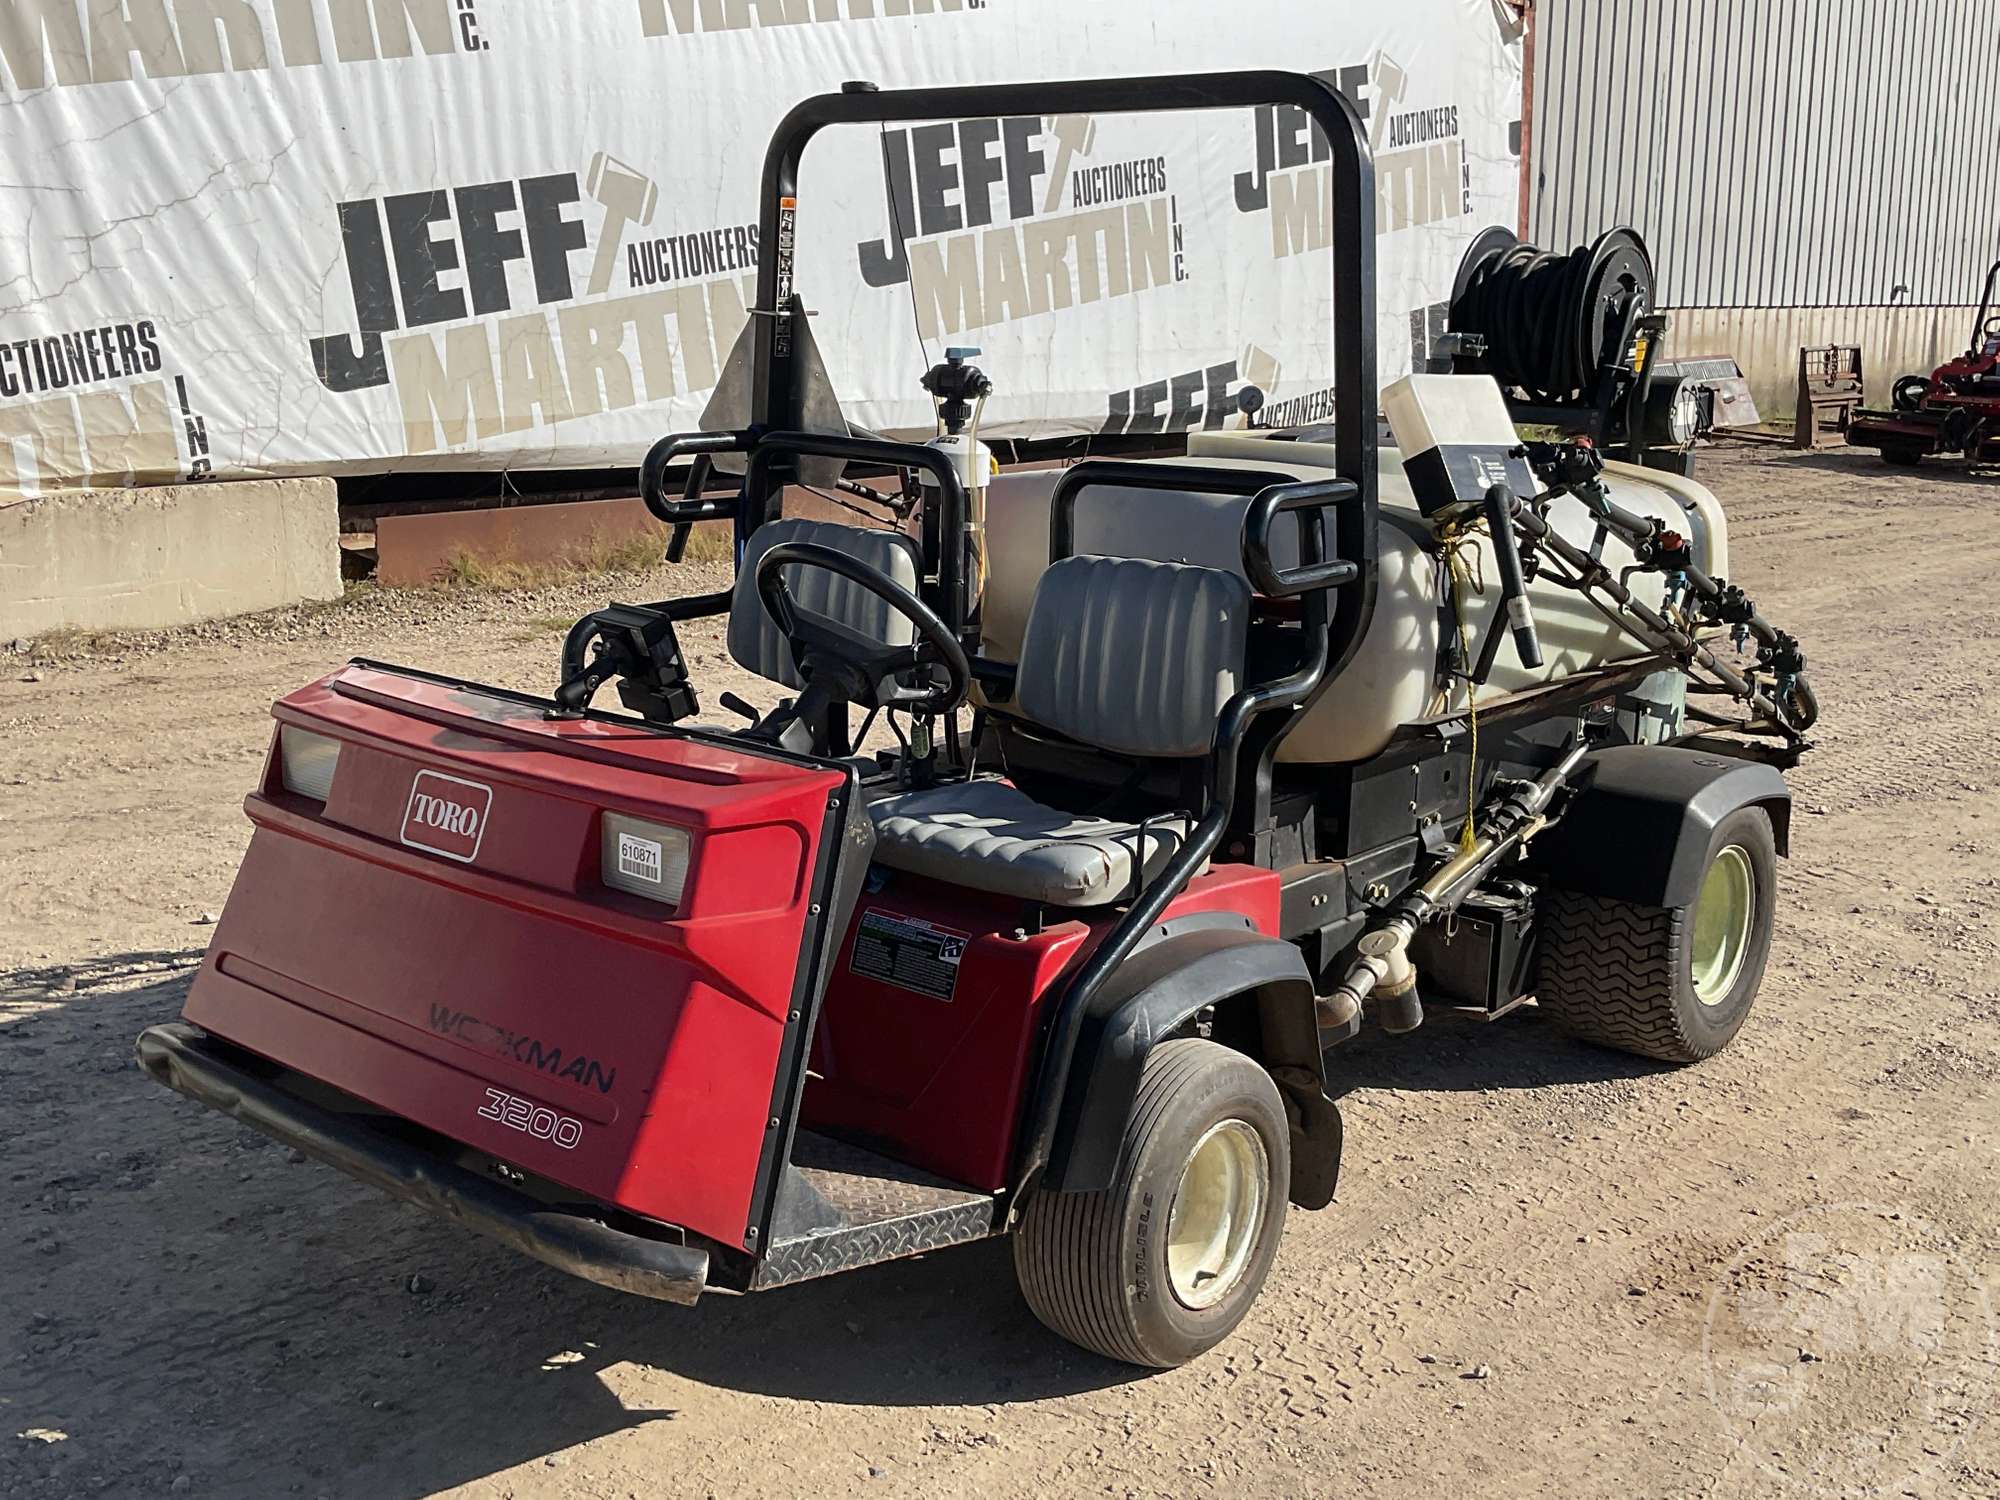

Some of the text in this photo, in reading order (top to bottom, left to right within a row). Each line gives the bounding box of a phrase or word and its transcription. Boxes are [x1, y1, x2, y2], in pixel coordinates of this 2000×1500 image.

[1390, 105, 1458, 148] AUCTIONEERS
[858, 116, 1045, 288] JEFF
[1073, 156, 1166, 208] AUCTIONEERS
[627, 222, 760, 288] AUCTIONEERS
[909, 197, 1171, 340] MARTIN
[1171, 195, 1189, 282] INC.
[309, 172, 588, 393] JEFF
[413, 793, 478, 837] TORO
[622, 843, 657, 865] 610871
[477, 1087, 583, 1149] 3200
